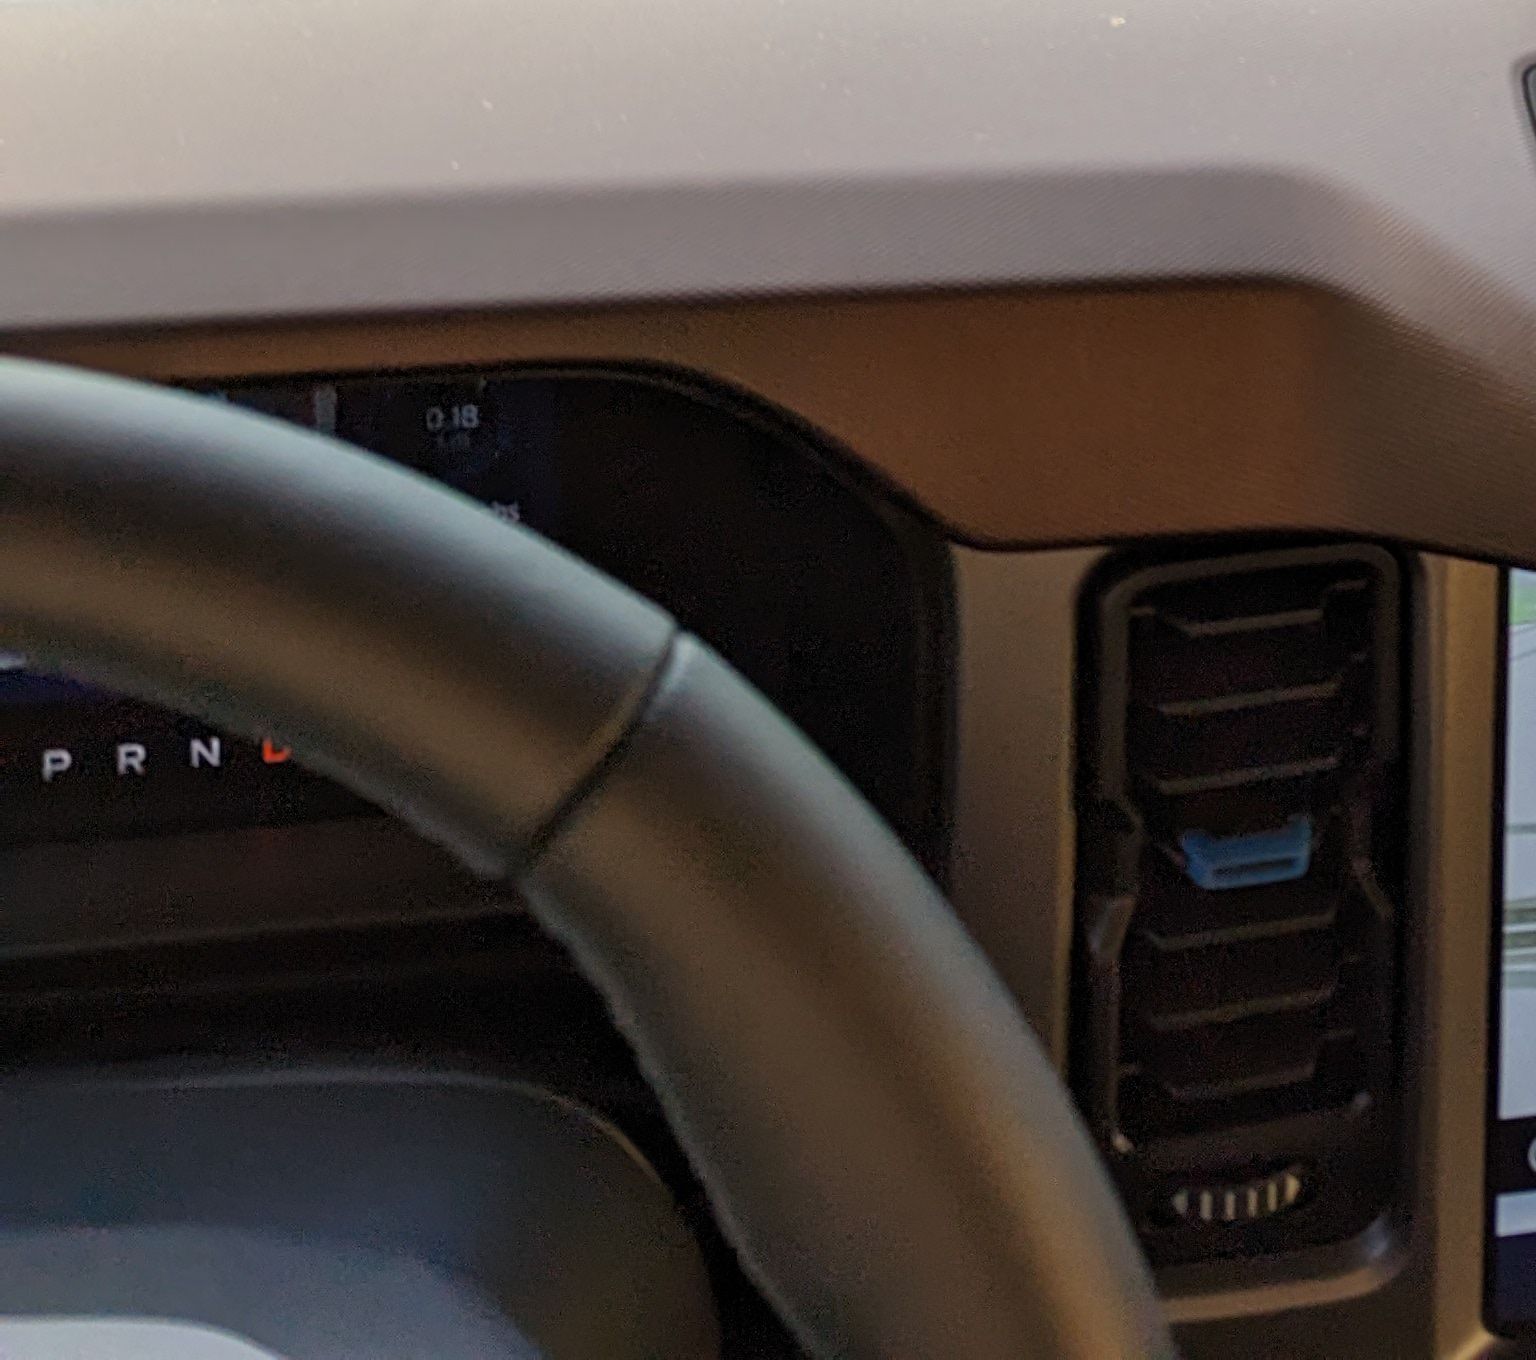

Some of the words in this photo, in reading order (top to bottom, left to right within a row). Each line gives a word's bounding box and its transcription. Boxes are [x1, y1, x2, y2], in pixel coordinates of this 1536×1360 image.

[42, 748, 72, 782] P
[117, 742, 147, 776] R
[190, 736, 221, 768] N
